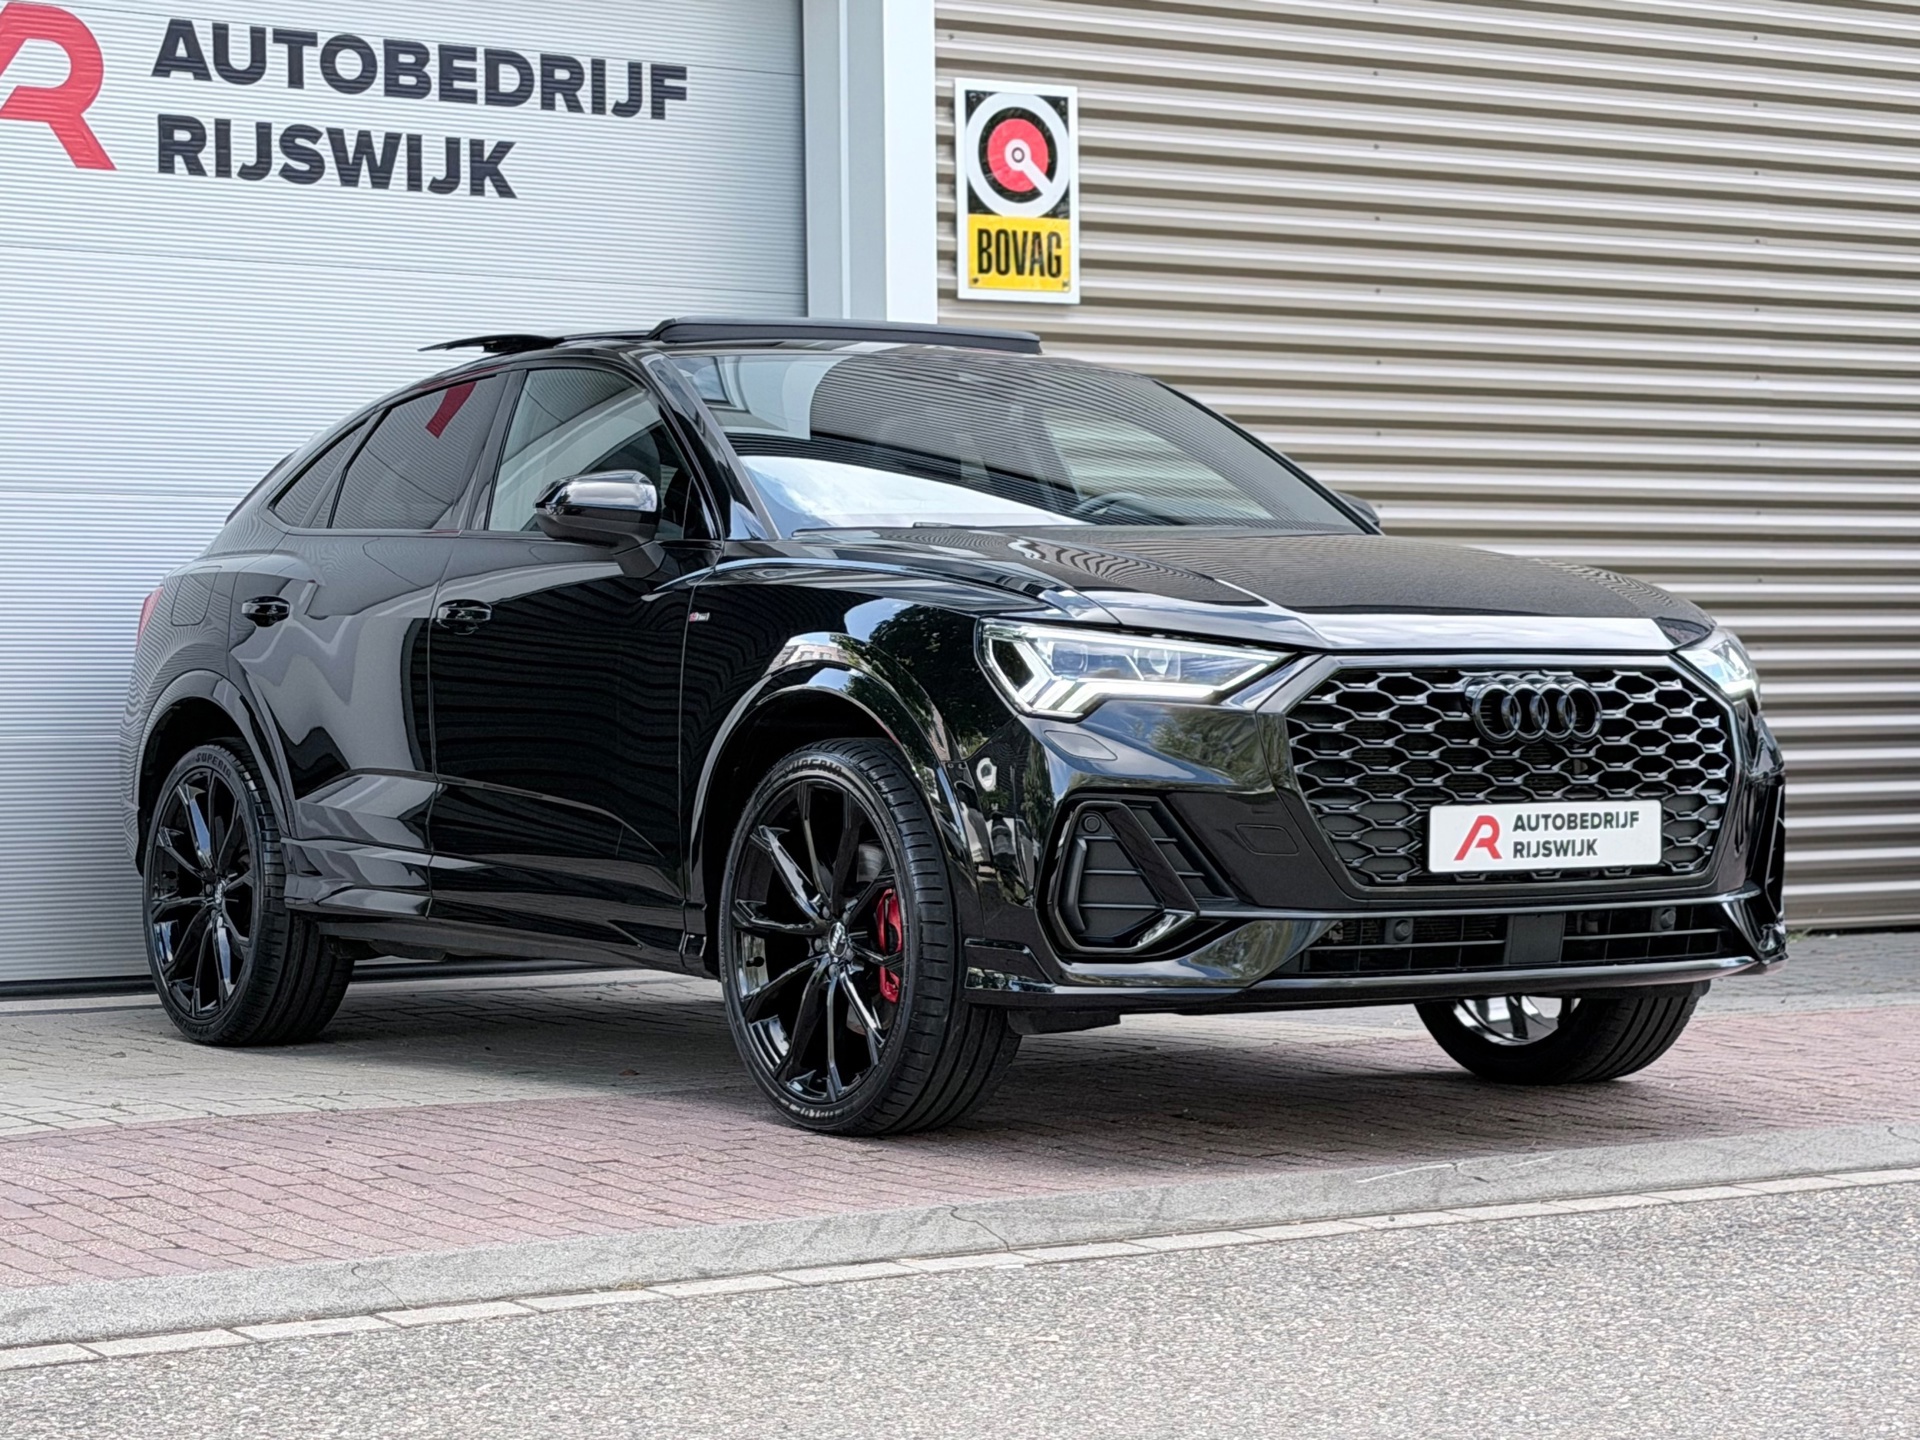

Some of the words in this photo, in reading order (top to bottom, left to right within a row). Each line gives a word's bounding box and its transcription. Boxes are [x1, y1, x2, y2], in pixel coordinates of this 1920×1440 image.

[151, 18, 688, 121] AUTOBEDRIJF
[156, 113, 518, 199] RIJSWIJK
[976, 227, 1063, 279] BOVAG
[1512, 811, 1640, 832] AUTOBEDRIJF
[1512, 838, 1598, 859] RIJSWIJK
